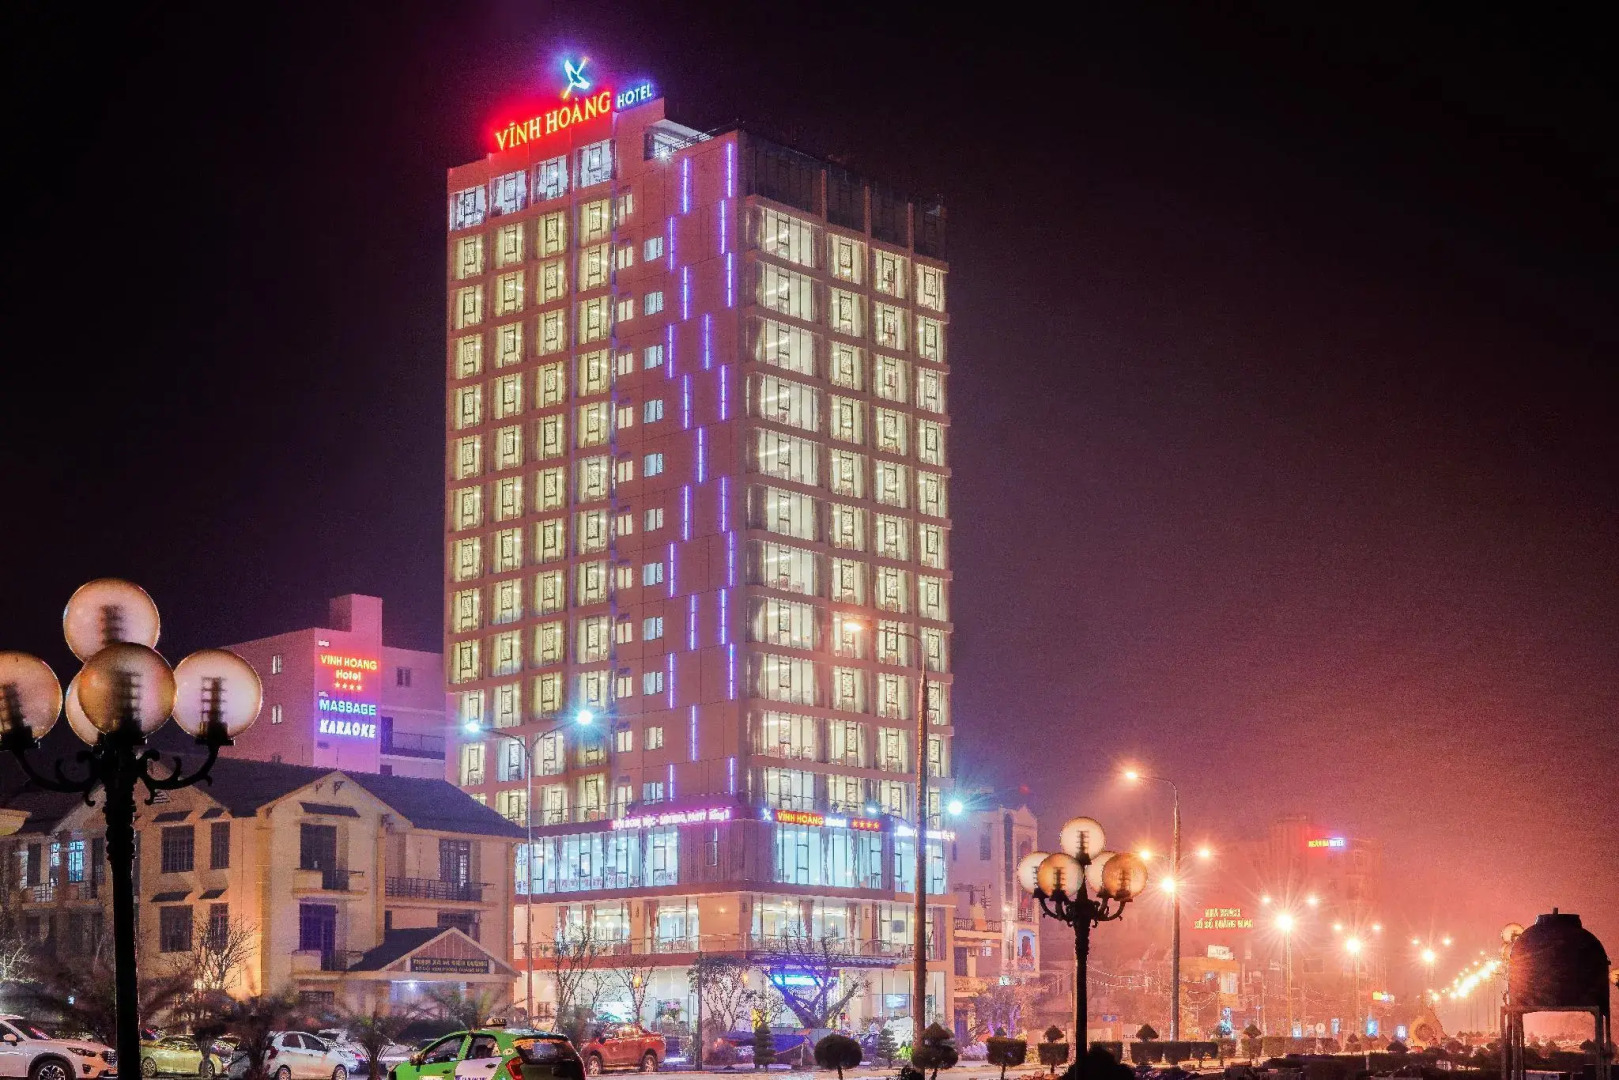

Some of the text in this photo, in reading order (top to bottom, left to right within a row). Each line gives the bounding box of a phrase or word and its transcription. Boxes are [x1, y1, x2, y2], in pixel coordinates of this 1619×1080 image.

[545, 91, 611, 135] HOÀNG
[617, 83, 653, 108] HOTEL
[335, 669, 362, 682] Hotel
[319, 699, 377, 716] MASSAGE
[319, 719, 377, 738] KARAOKE
